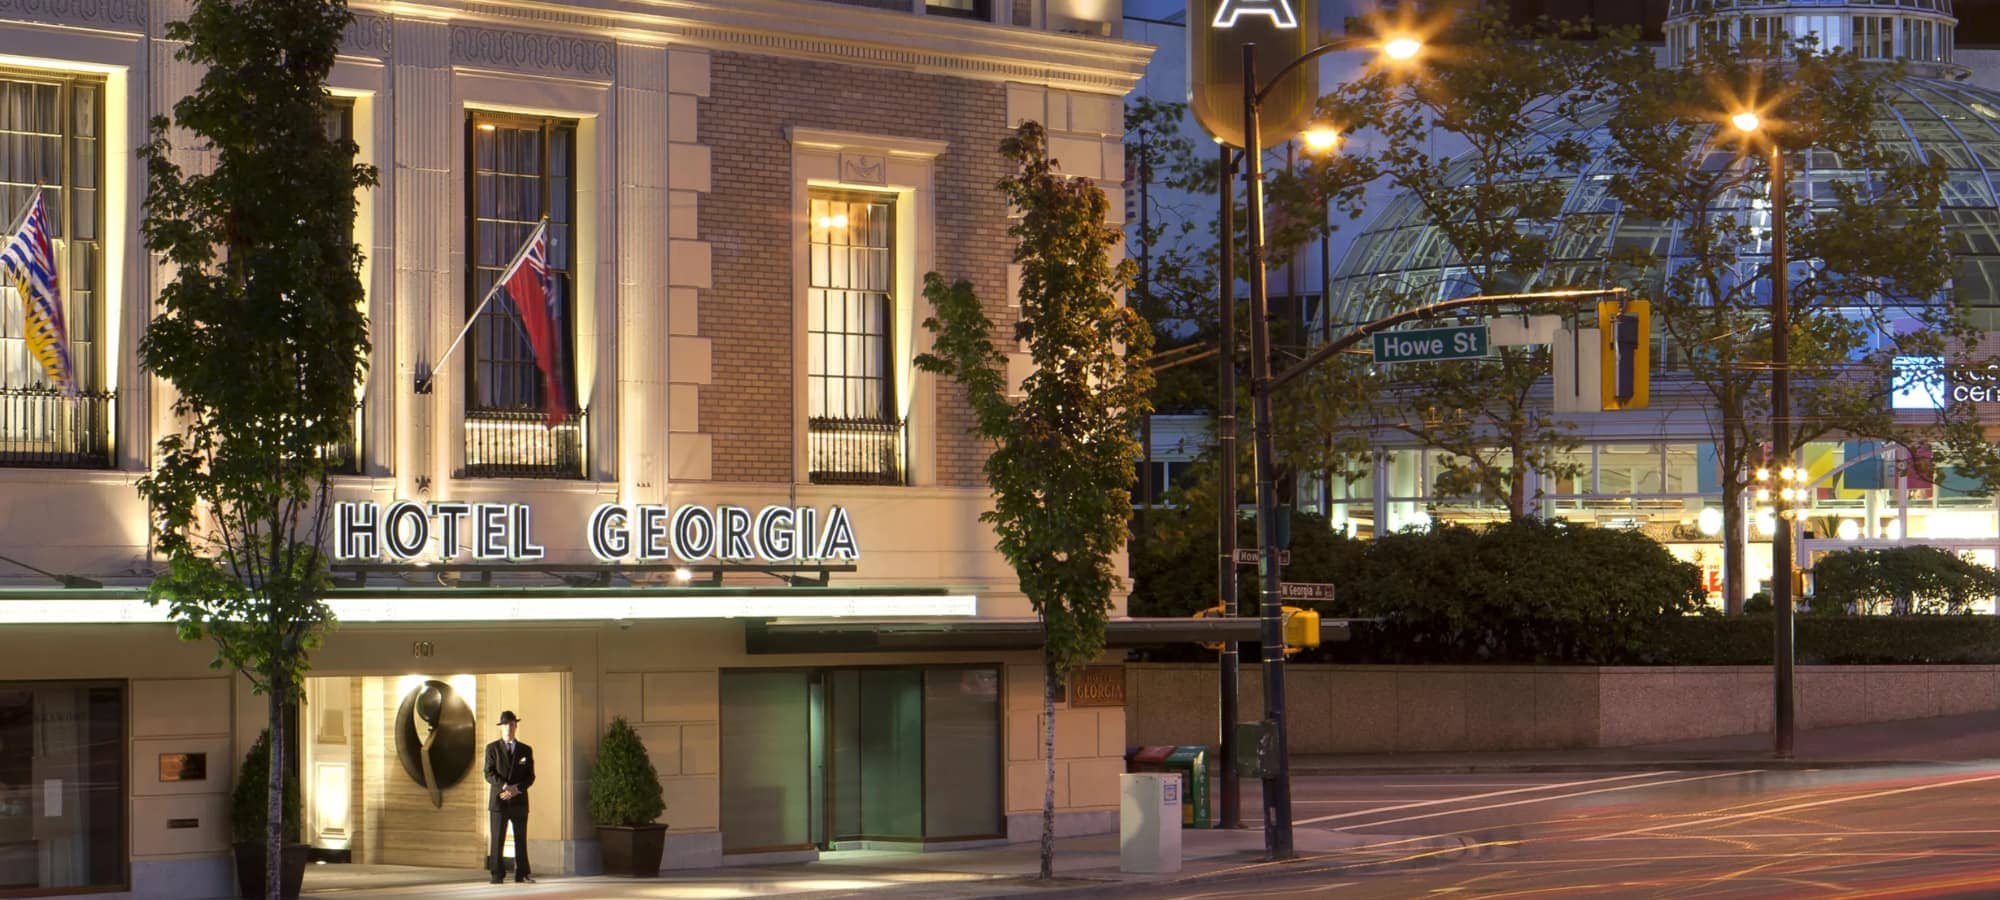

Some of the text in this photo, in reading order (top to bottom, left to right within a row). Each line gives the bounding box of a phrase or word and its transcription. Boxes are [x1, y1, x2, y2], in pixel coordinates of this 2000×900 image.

[1384, 332, 1477, 357] Howe St
[333, 502, 860, 561] HOTEL GEORGIA
[1288, 584, 1314, 598] Georgia
[1077, 685, 1122, 698] GEORGIA
